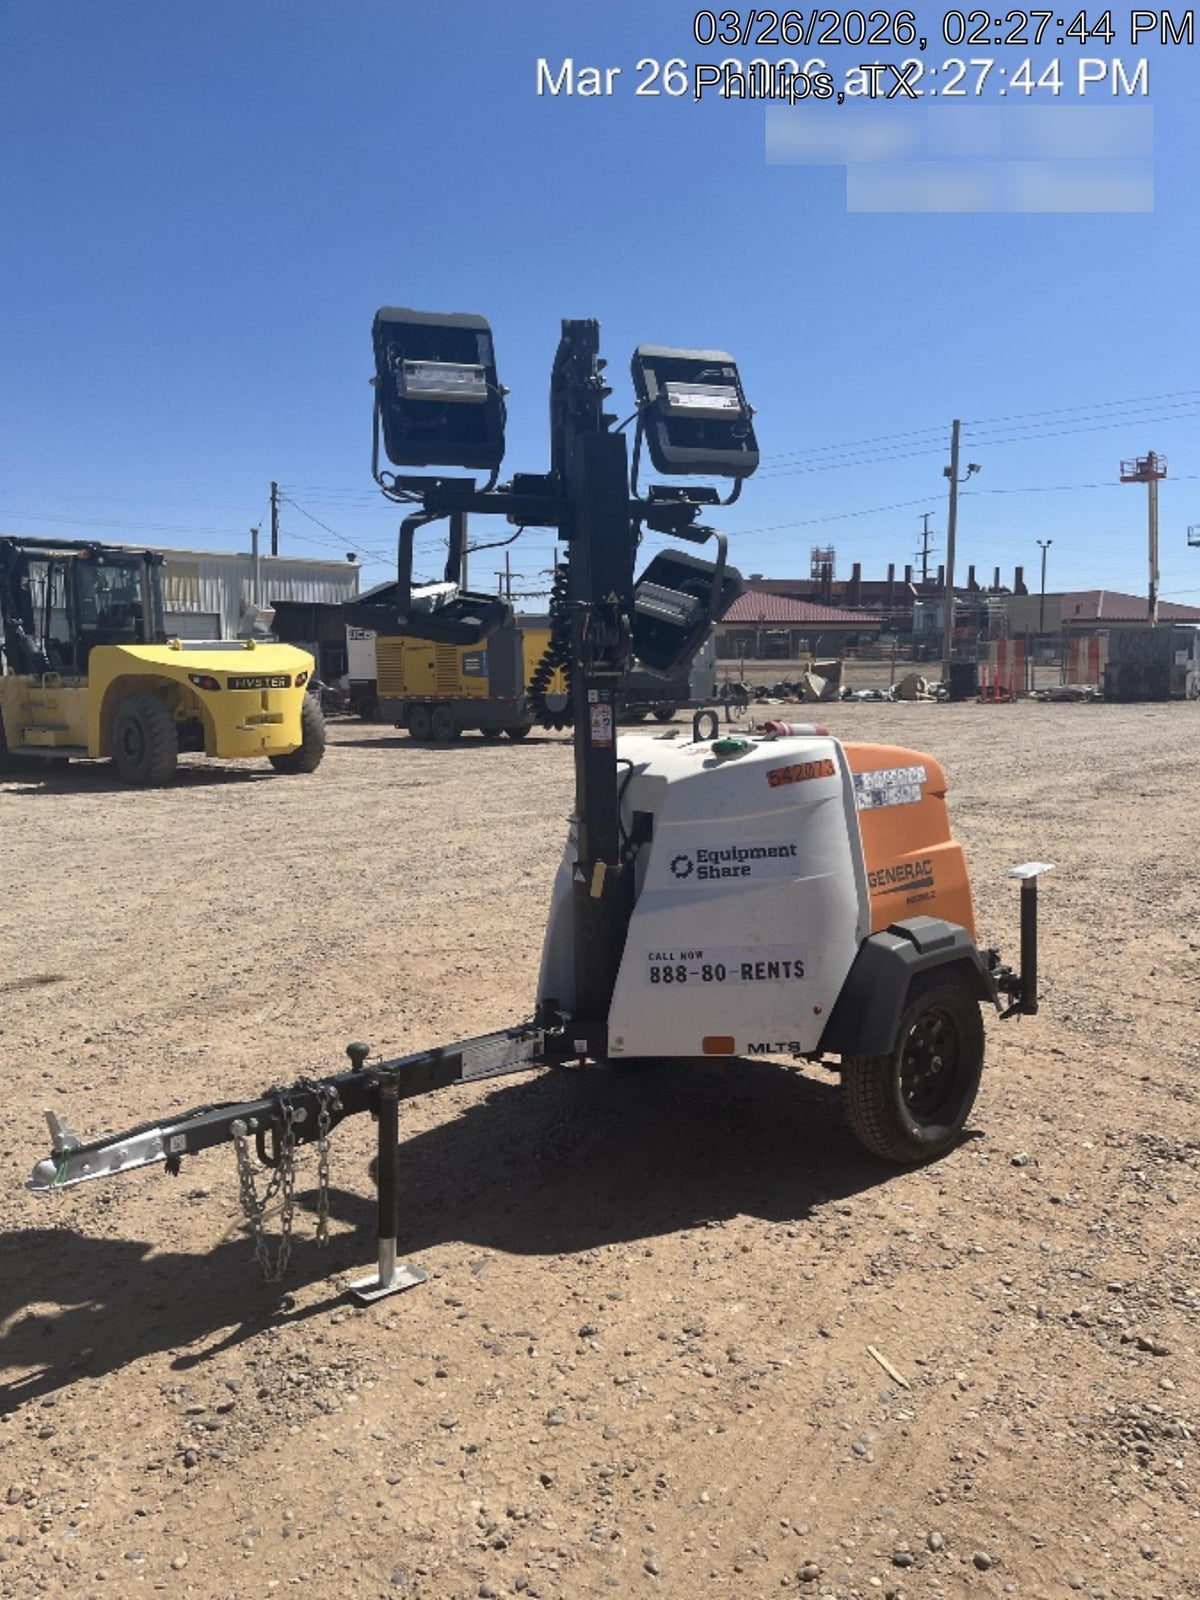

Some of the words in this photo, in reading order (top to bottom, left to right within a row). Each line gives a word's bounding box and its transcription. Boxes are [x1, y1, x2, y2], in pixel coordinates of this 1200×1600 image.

[235, 677, 286, 688] HYSTER
[696, 843, 798, 864] Equipment
[696, 865, 751, 879] Share
[867, 859, 932, 888] GENERAC
[648, 952, 675, 961] CALL
[680, 950, 704, 960] NOW
[650, 960, 805, 984] 888-80-RENTS
